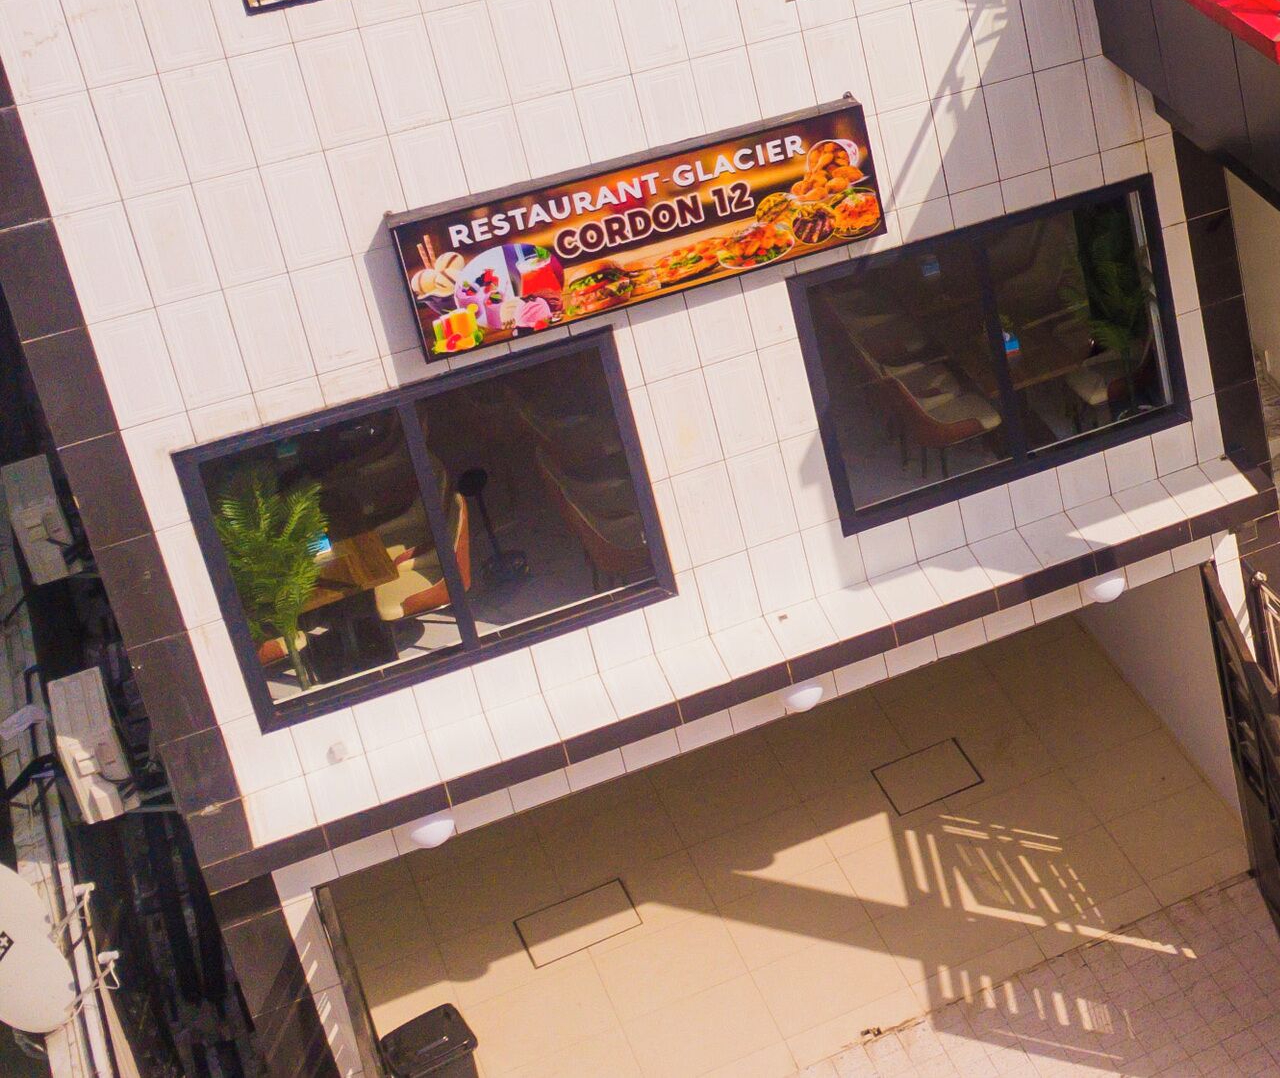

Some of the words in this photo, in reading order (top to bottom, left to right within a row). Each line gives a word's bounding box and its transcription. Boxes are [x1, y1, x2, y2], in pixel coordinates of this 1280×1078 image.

[448, 135, 806, 249] RESTAURANT-GLACIER
[554, 192, 706, 260] CORDON
[715, 181, 755, 218] 12
